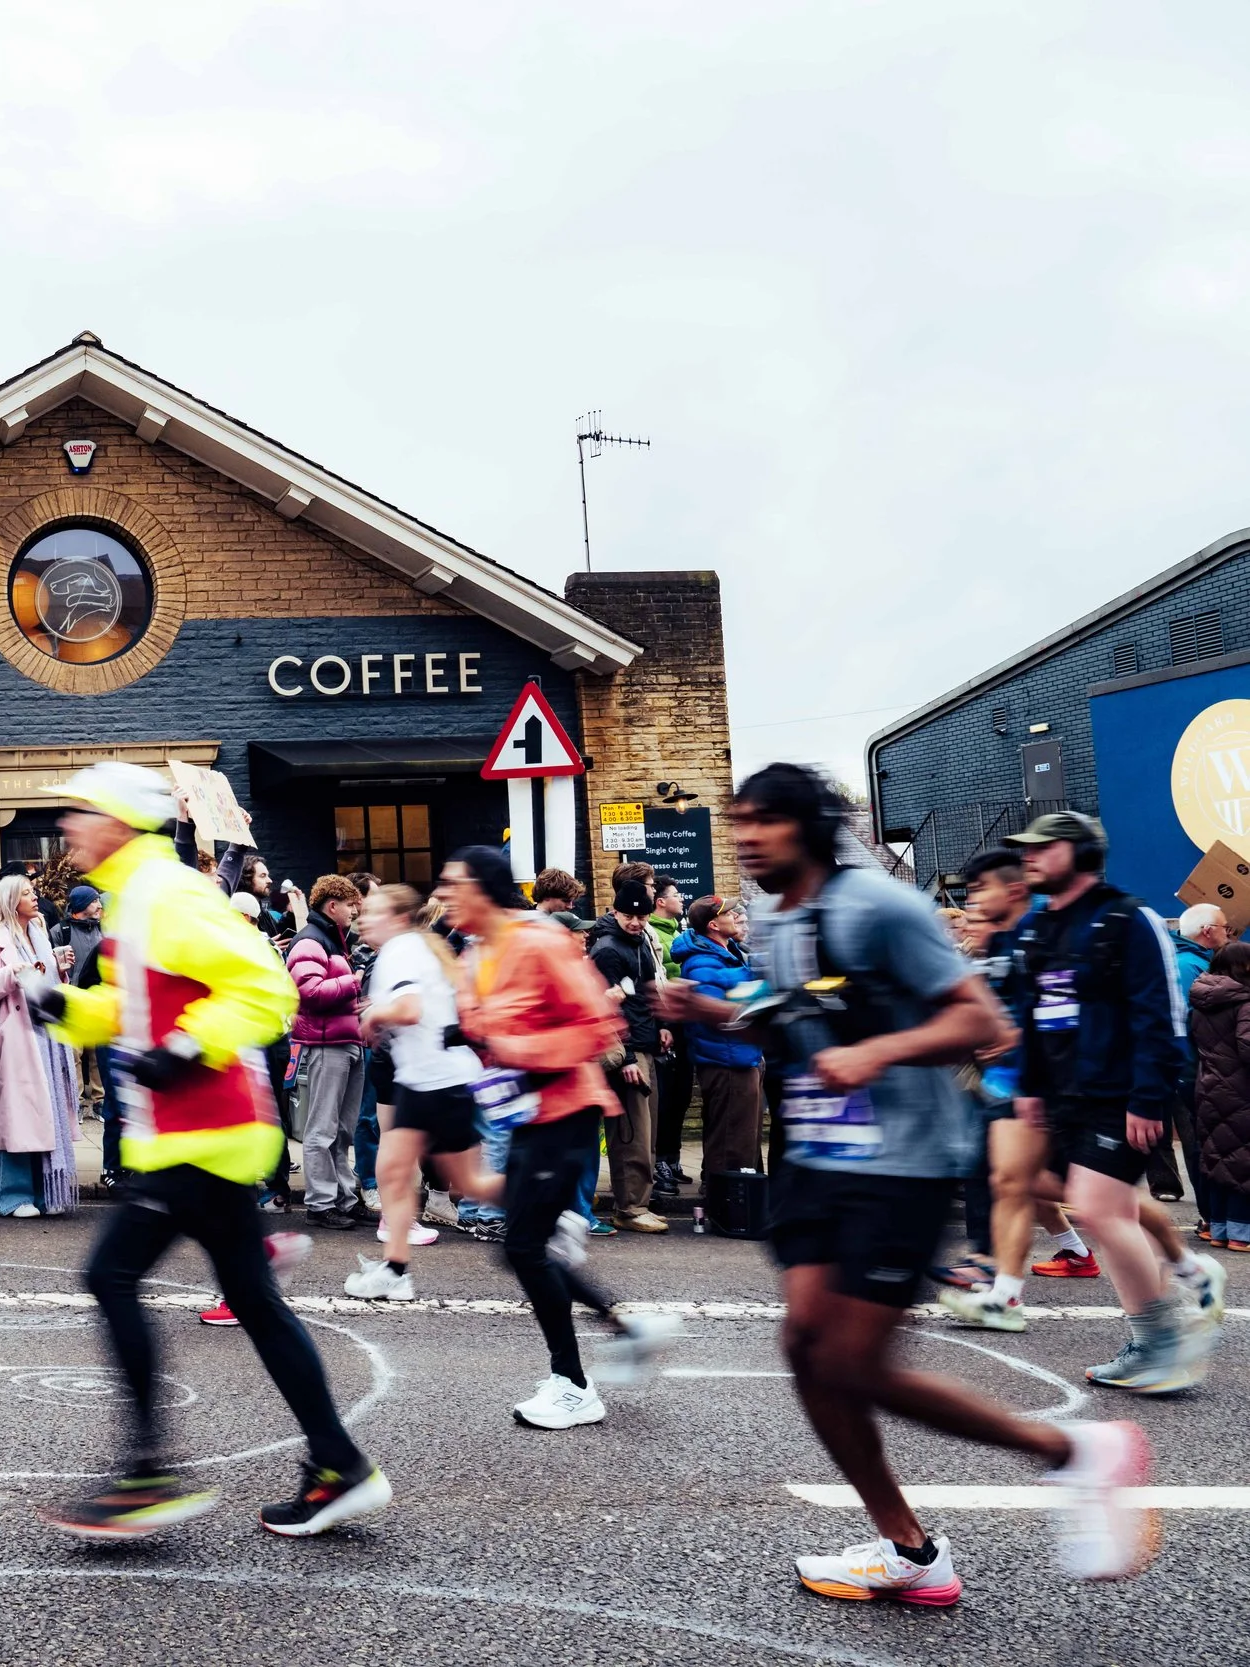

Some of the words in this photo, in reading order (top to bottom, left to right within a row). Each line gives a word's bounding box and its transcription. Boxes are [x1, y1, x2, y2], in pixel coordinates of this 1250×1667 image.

[268, 653, 483, 696] COFFEE
[2, 779, 31, 789] THE
[645, 831, 671, 840] eciality
[672, 830, 697, 838] Coffee
[645, 847, 667, 855] Single
[668, 846, 690, 855] Origin
